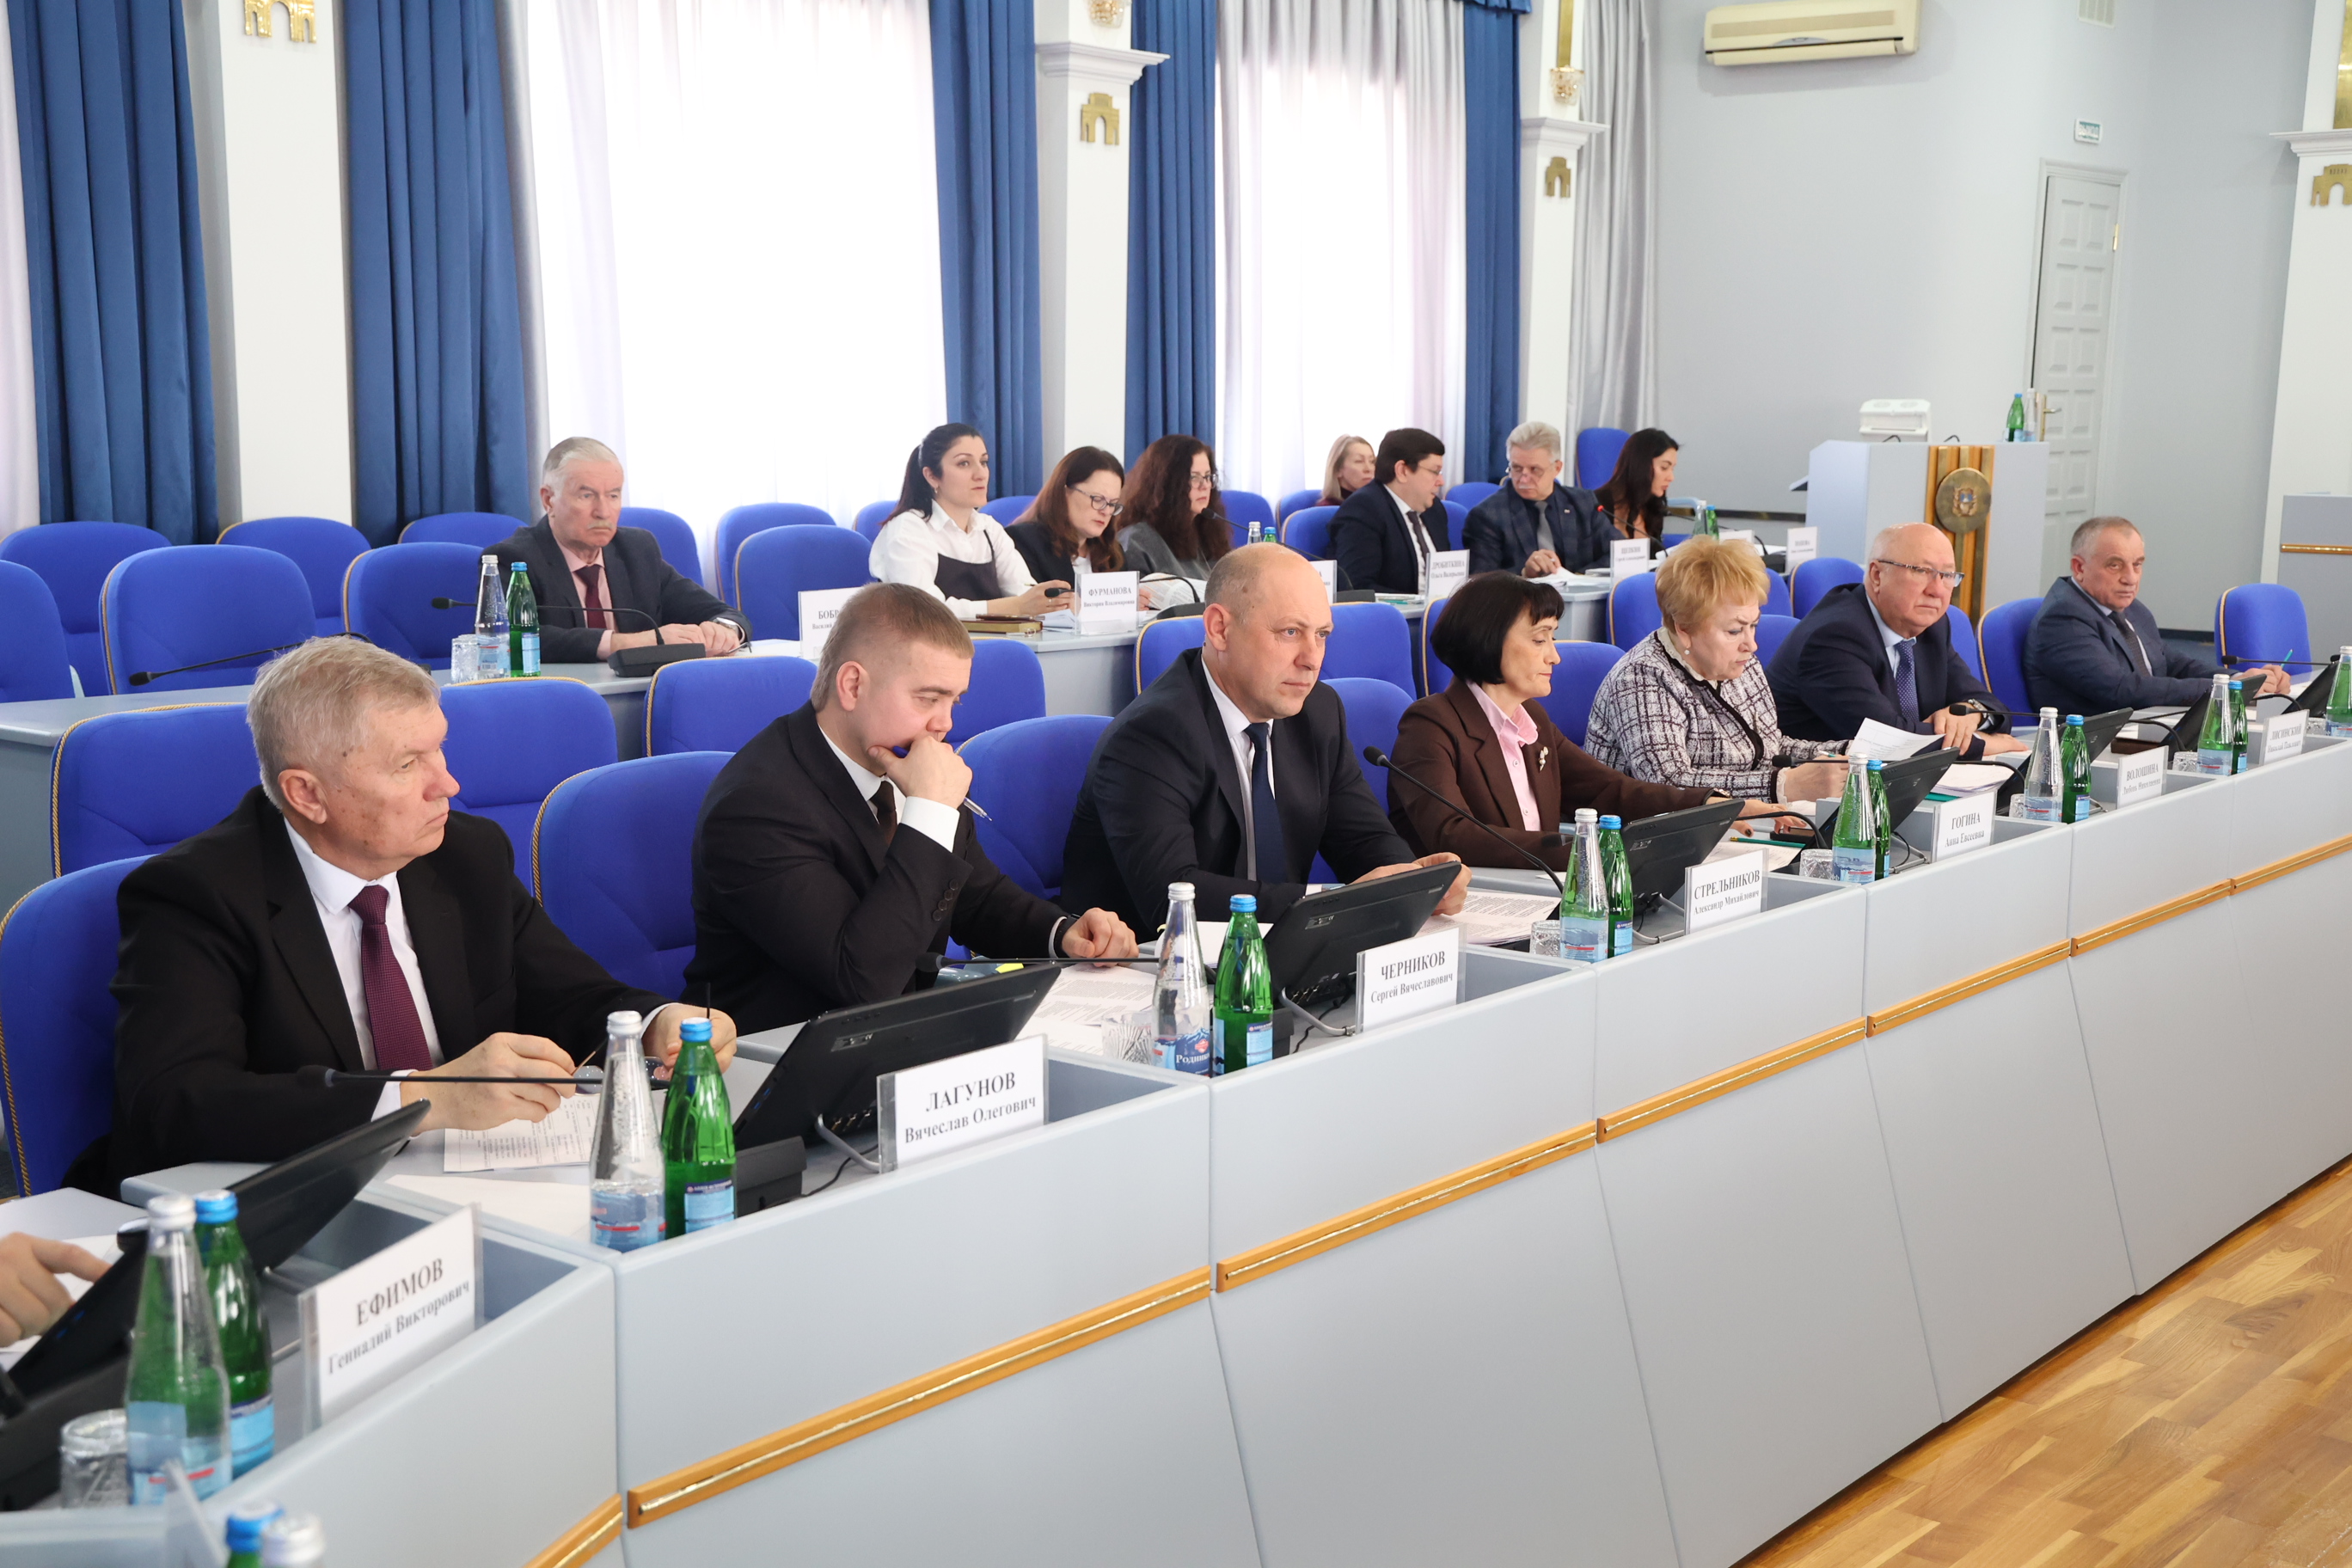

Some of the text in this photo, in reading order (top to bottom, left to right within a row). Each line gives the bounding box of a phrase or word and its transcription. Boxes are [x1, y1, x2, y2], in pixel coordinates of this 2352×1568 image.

[1088, 587, 1132, 596] ФУРМАНОВА
[2126, 763, 2159, 781] ВОЛОШИНА
[1951, 812, 1981, 830] ГОГИНА
[1945, 830, 1985, 848] Анна Евсеевна
[1694, 869, 1760, 900] СТРЕЛЬНИКОВ
[1694, 890, 1760, 916] Александр Михайлович
[1381, 951, 1445, 980] ЧЕРНИКОВ
[1370, 973, 1453, 1004] Сергей Вячеславович
[926, 1072, 1015, 1112] ЛАГУНОВ
[905, 1096, 1036, 1143] Вячеслав Олегович
[356, 1258, 444, 1326] ЕФИМОВ
[328, 1279, 470, 1375] Геннадий Викторович
